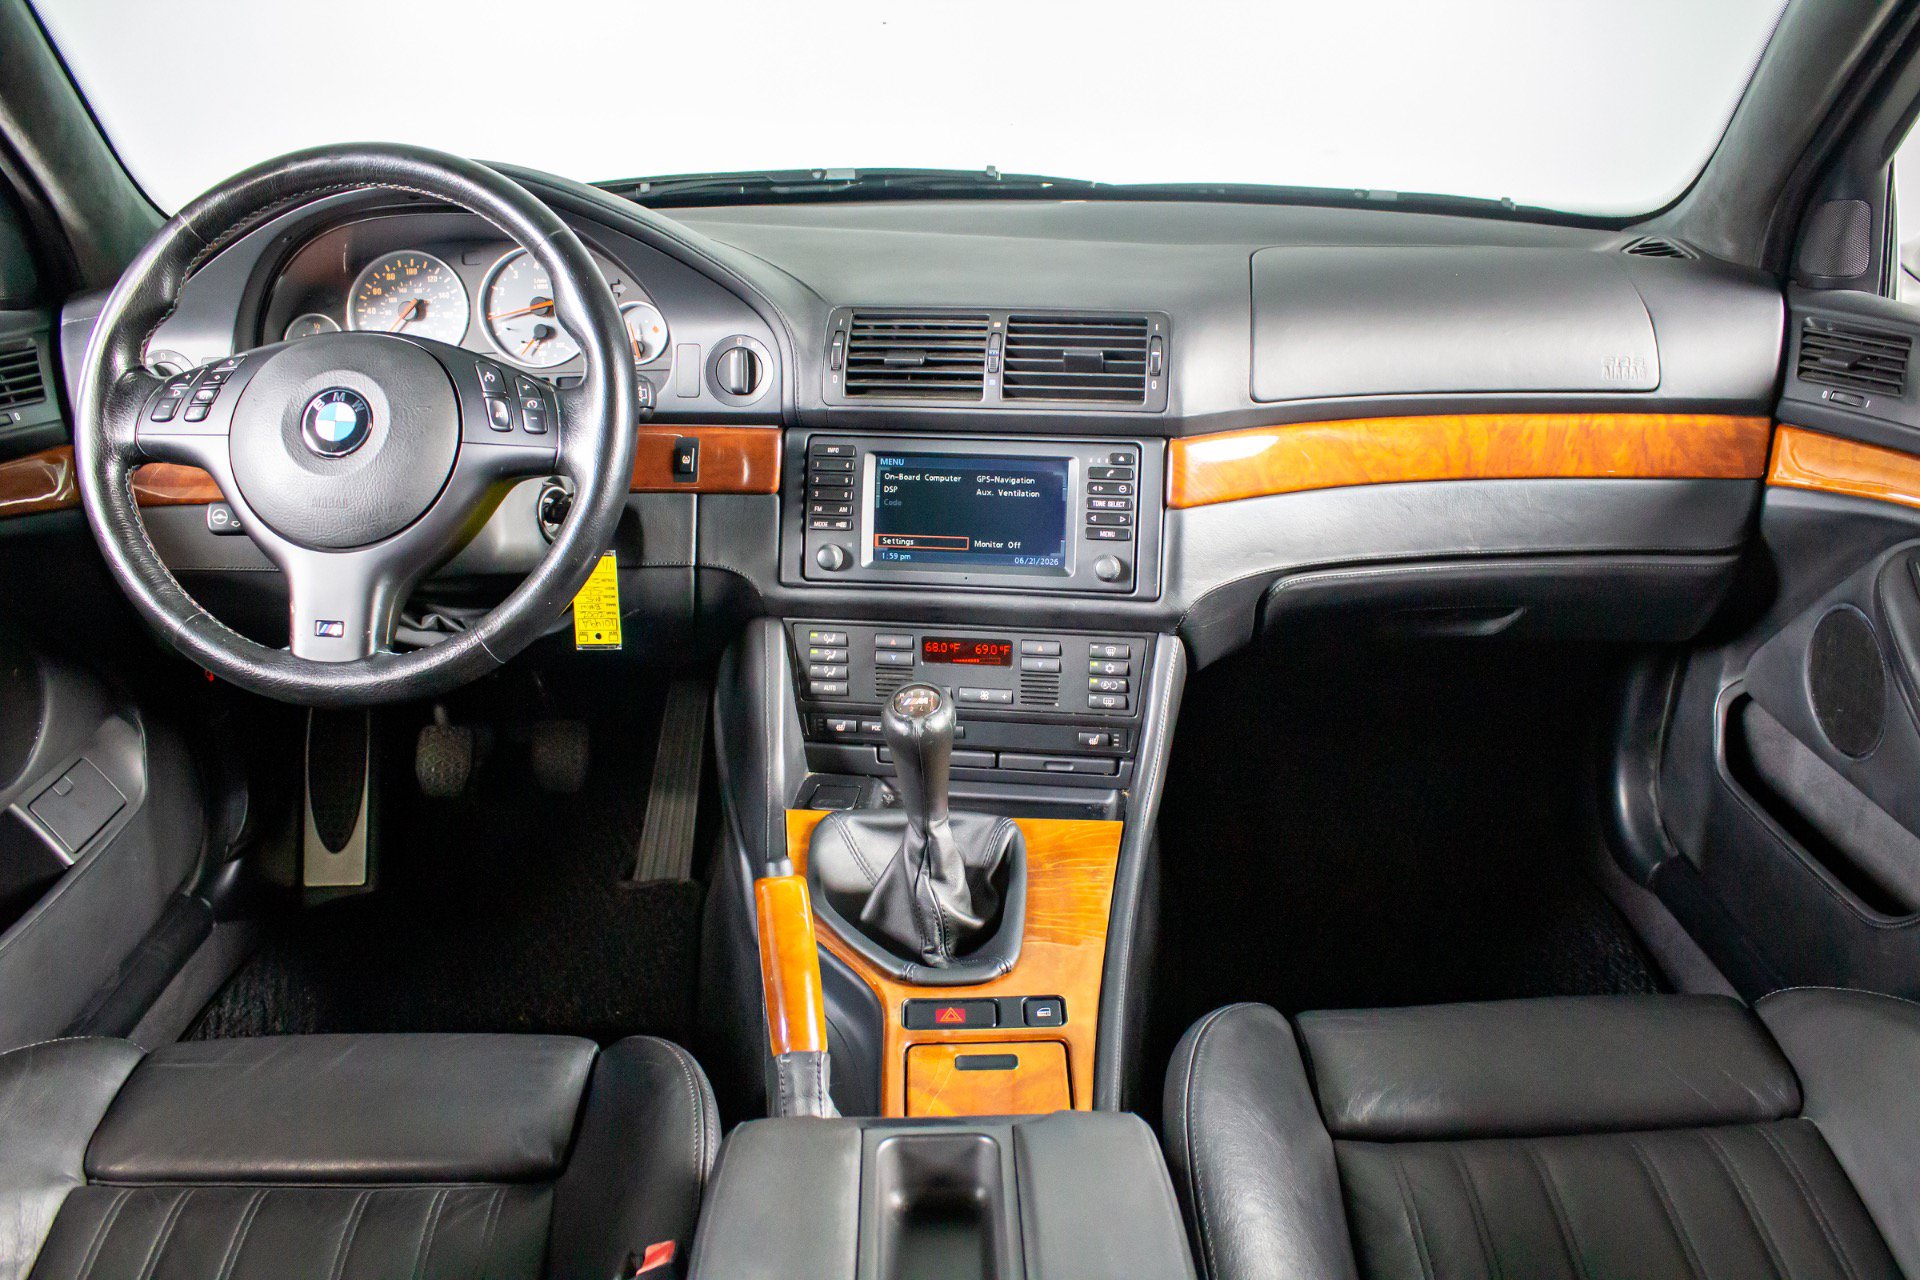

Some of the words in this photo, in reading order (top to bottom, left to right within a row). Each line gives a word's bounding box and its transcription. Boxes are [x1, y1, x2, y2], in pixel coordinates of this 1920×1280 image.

[312, 391, 366, 413] BMW
[880, 458, 905, 466] MENU
[884, 472, 921, 481] On-Board
[924, 474, 962, 483] Computer
[976, 475, 1036, 485] GPS-Navigation
[883, 485, 899, 493] DSP
[975, 488, 995, 496] Aux.
[998, 489, 1040, 498] Ventilation
[1107, 500, 1126, 508] SELECT
[1099, 530, 1116, 538] MENU
[882, 537, 914, 547] Settings
[974, 540, 1004, 549] Monitor
[1007, 541, 1022, 549] Off
[882, 552, 899, 560] 1:59
[899, 553, 912, 561] pm
[1014, 556, 1059, 566] 06/21/2026
[823, 684, 837, 692] AUTO
